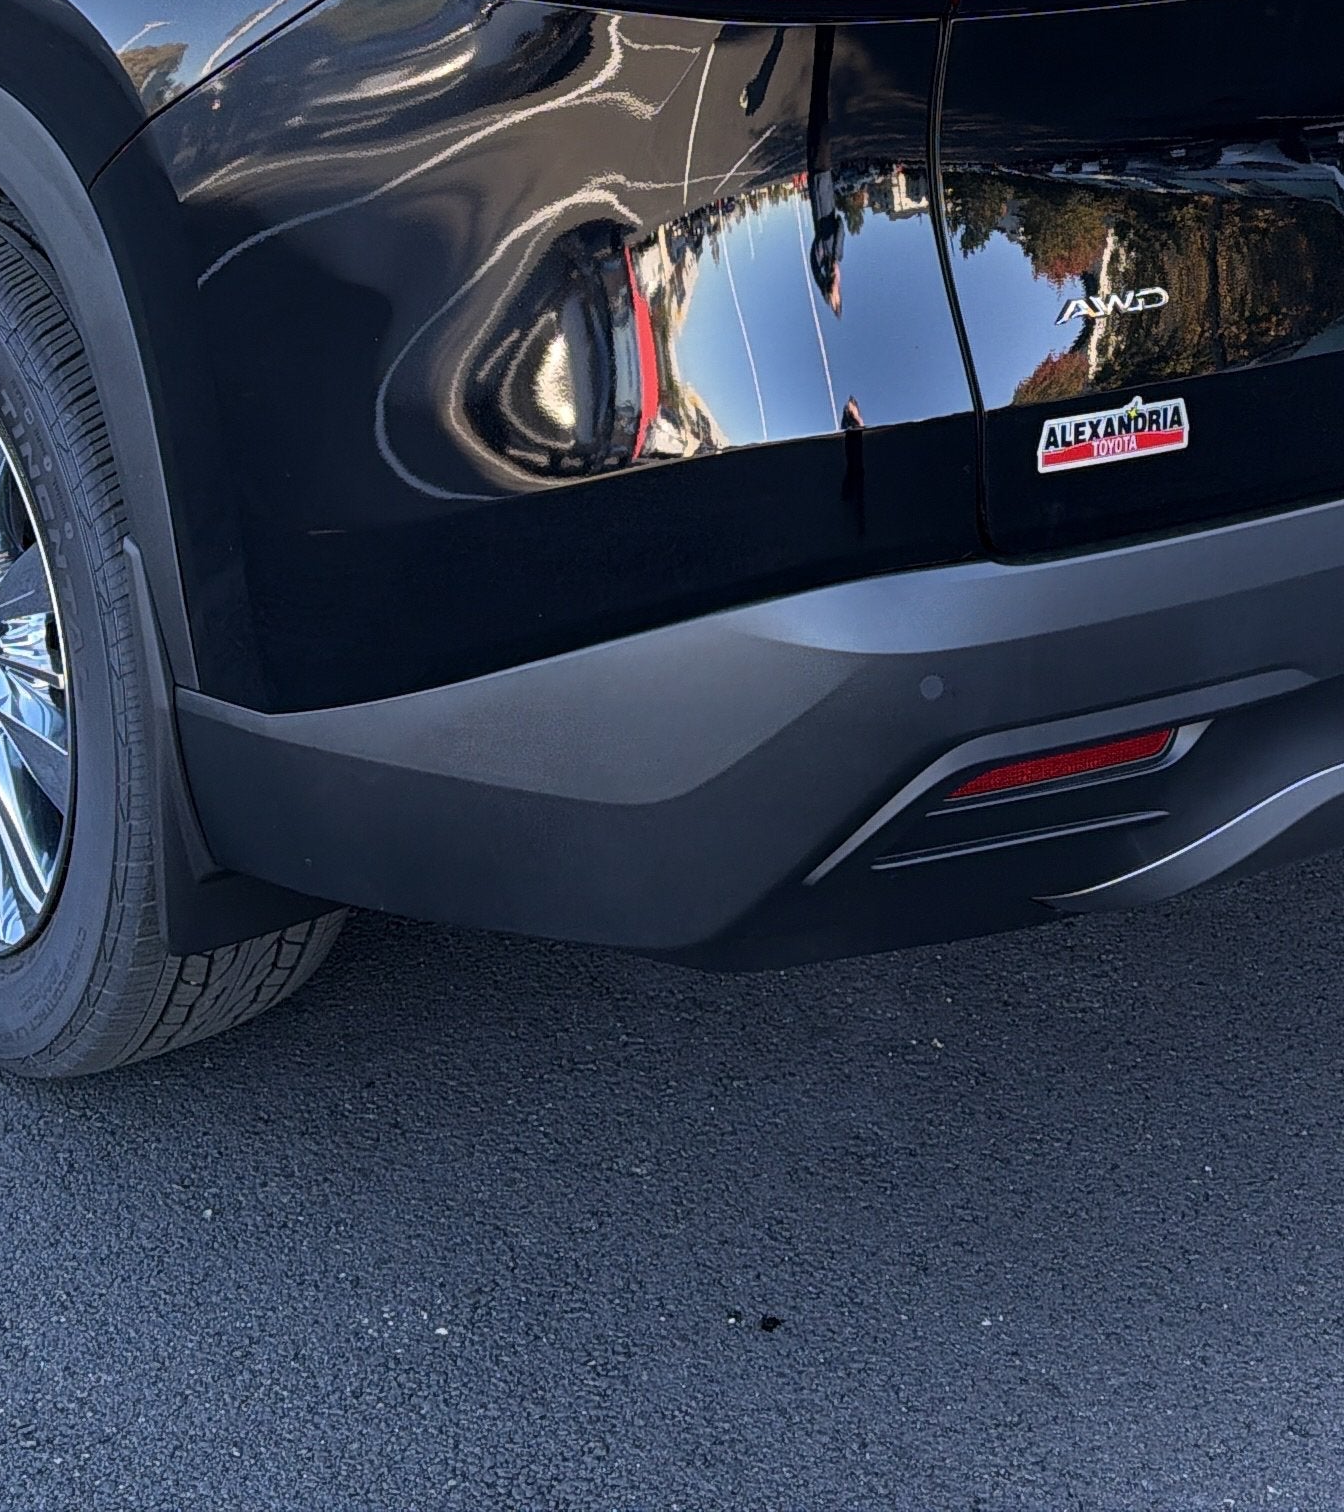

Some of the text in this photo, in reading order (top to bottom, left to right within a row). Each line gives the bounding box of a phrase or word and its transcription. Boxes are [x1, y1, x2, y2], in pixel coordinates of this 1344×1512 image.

[1055, 286, 1170, 326] AWD
[1044, 405, 1184, 451] ALEXANDRIA
[1092, 435, 1138, 457] TOYOTA
